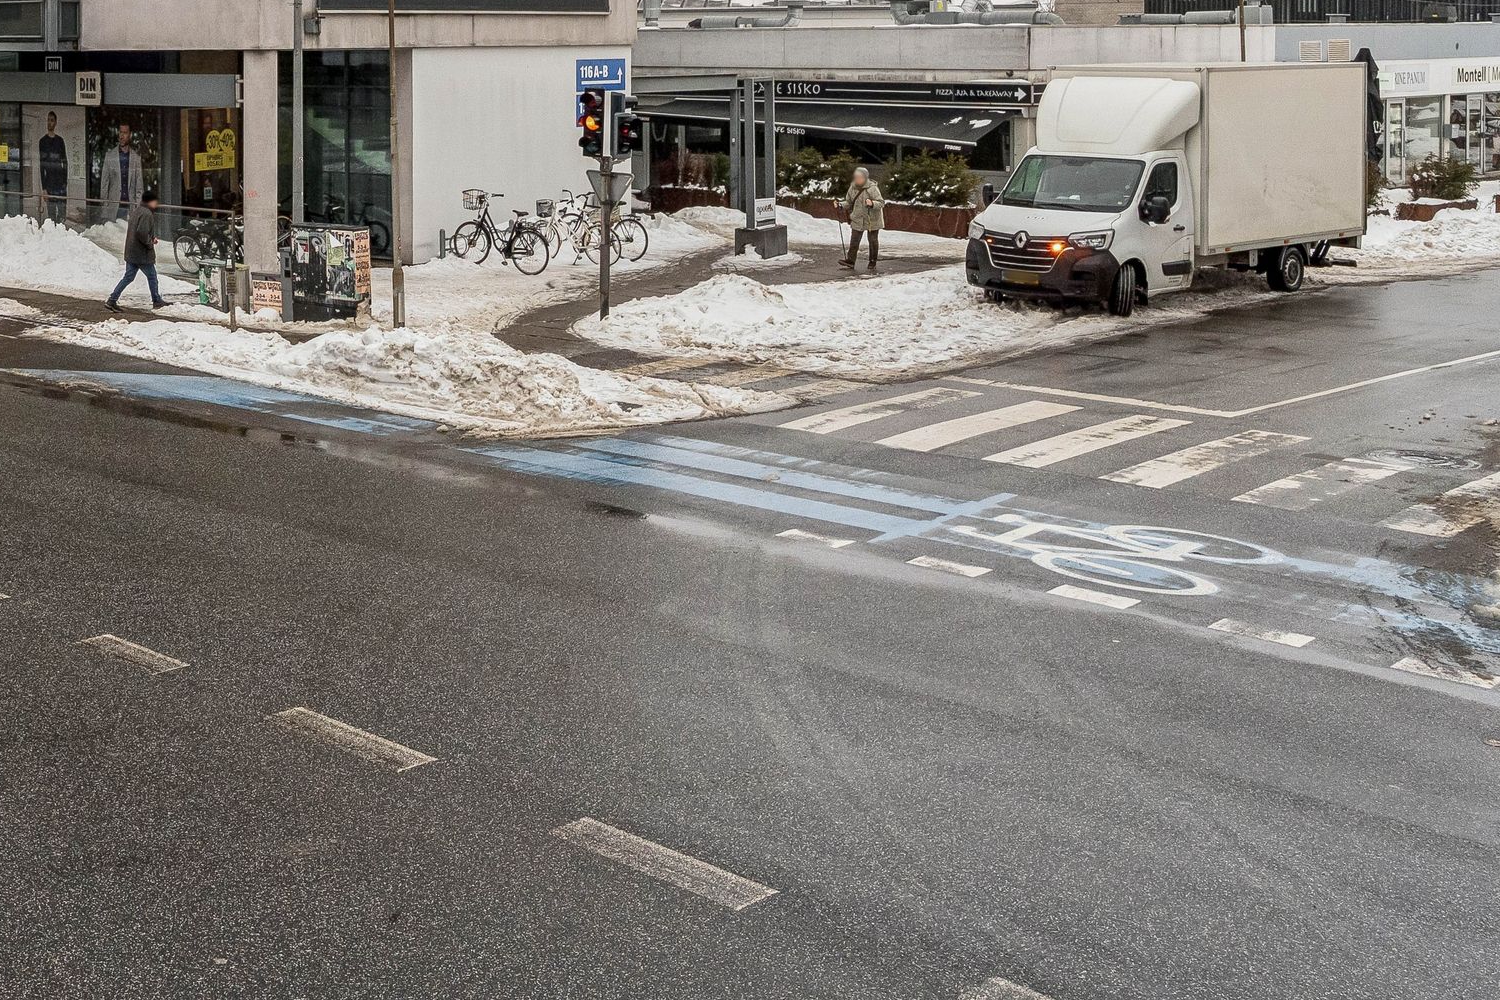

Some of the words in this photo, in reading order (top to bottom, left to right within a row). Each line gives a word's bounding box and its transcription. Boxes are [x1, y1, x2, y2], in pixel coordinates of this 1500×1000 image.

[48, 60, 59, 70] DIN
[1457, 67, 1487, 83] Montell
[79, 77, 96, 92] DIN
[786, 82, 821, 95] SISKO
[976, 89, 1013, 98] TAKEAWAY
[786, 126, 806, 135] SISKO
